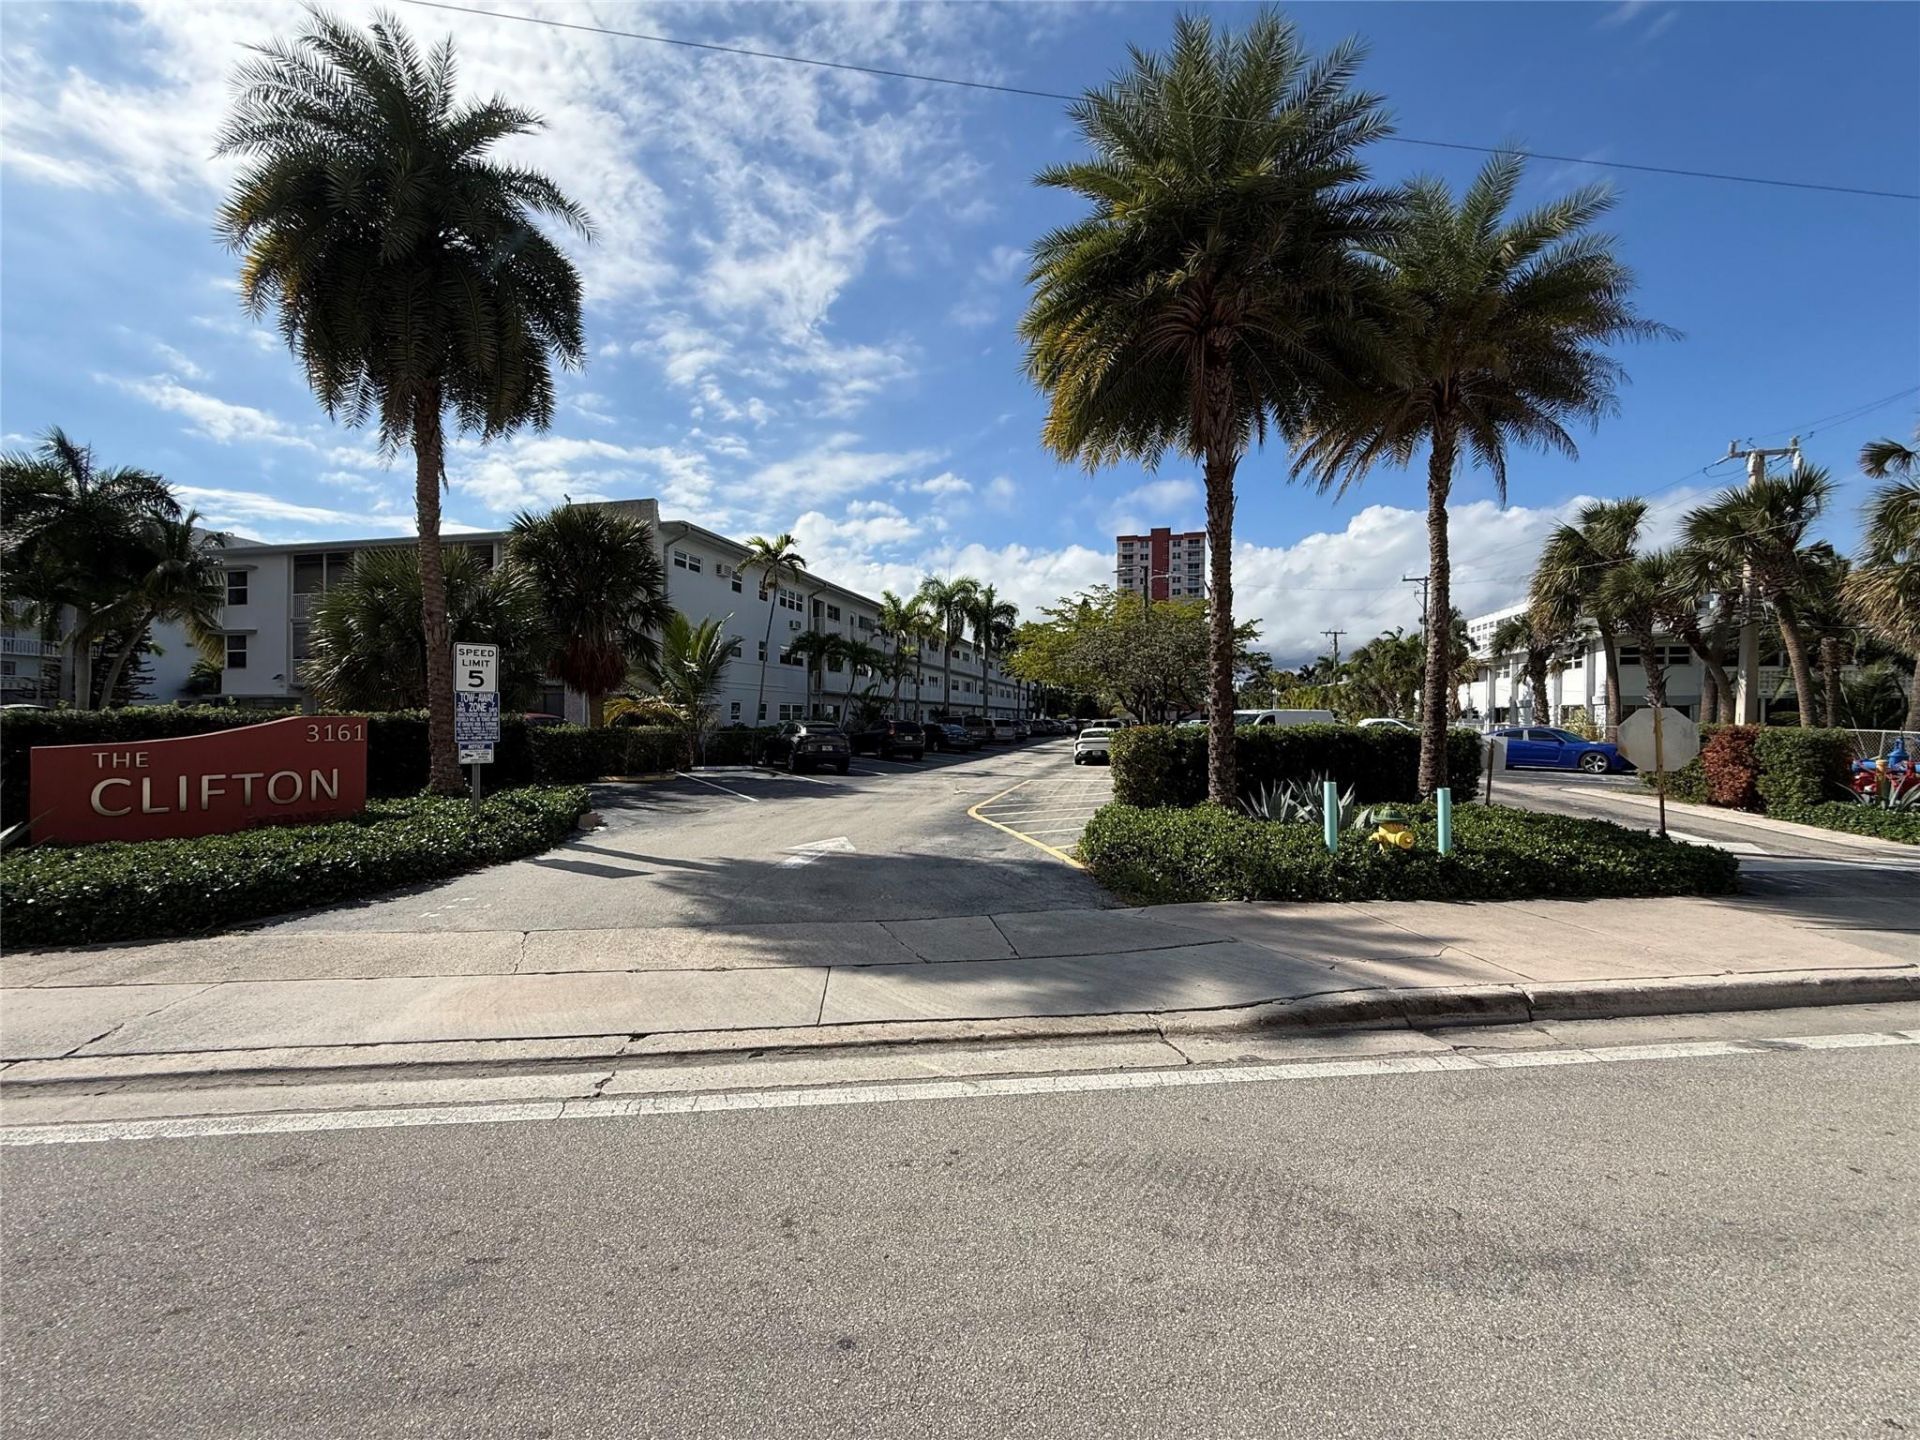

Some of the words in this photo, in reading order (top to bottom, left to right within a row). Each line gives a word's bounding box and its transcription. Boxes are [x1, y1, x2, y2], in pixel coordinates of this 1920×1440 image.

[458, 648, 495, 658] SPEED
[462, 659, 491, 668] LIMIT
[468, 669, 485, 688] 5
[459, 692, 495, 703] TOW-AWAY
[468, 702, 488, 712] ZONE
[306, 723, 365, 743] 3161
[92, 751, 149, 769] THE
[89, 767, 339, 817] CLIFTON
